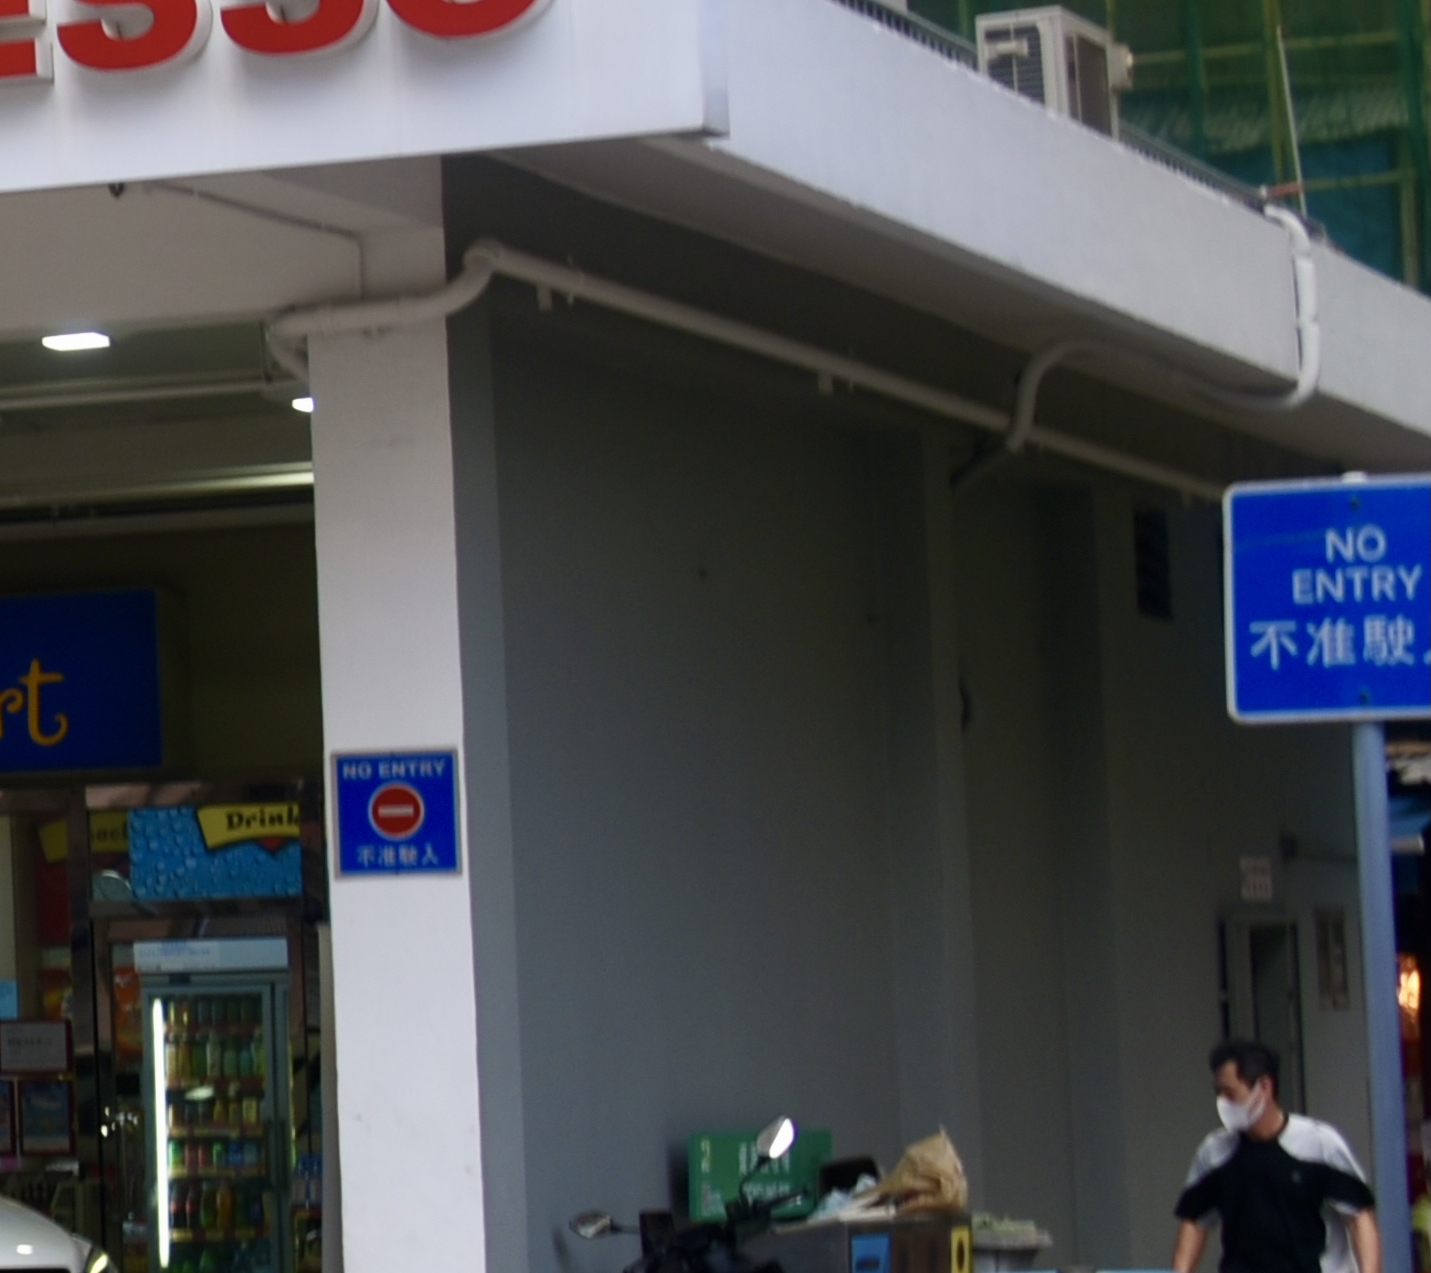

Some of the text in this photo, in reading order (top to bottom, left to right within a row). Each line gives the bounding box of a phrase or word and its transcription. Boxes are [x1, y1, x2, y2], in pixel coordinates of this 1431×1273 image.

[1325, 524, 1387, 563] NO
[1291, 564, 1423, 605] ENTRY
[1249, 615, 1431, 671] 不准駛
[343, 759, 445, 779] NO ENTRY
